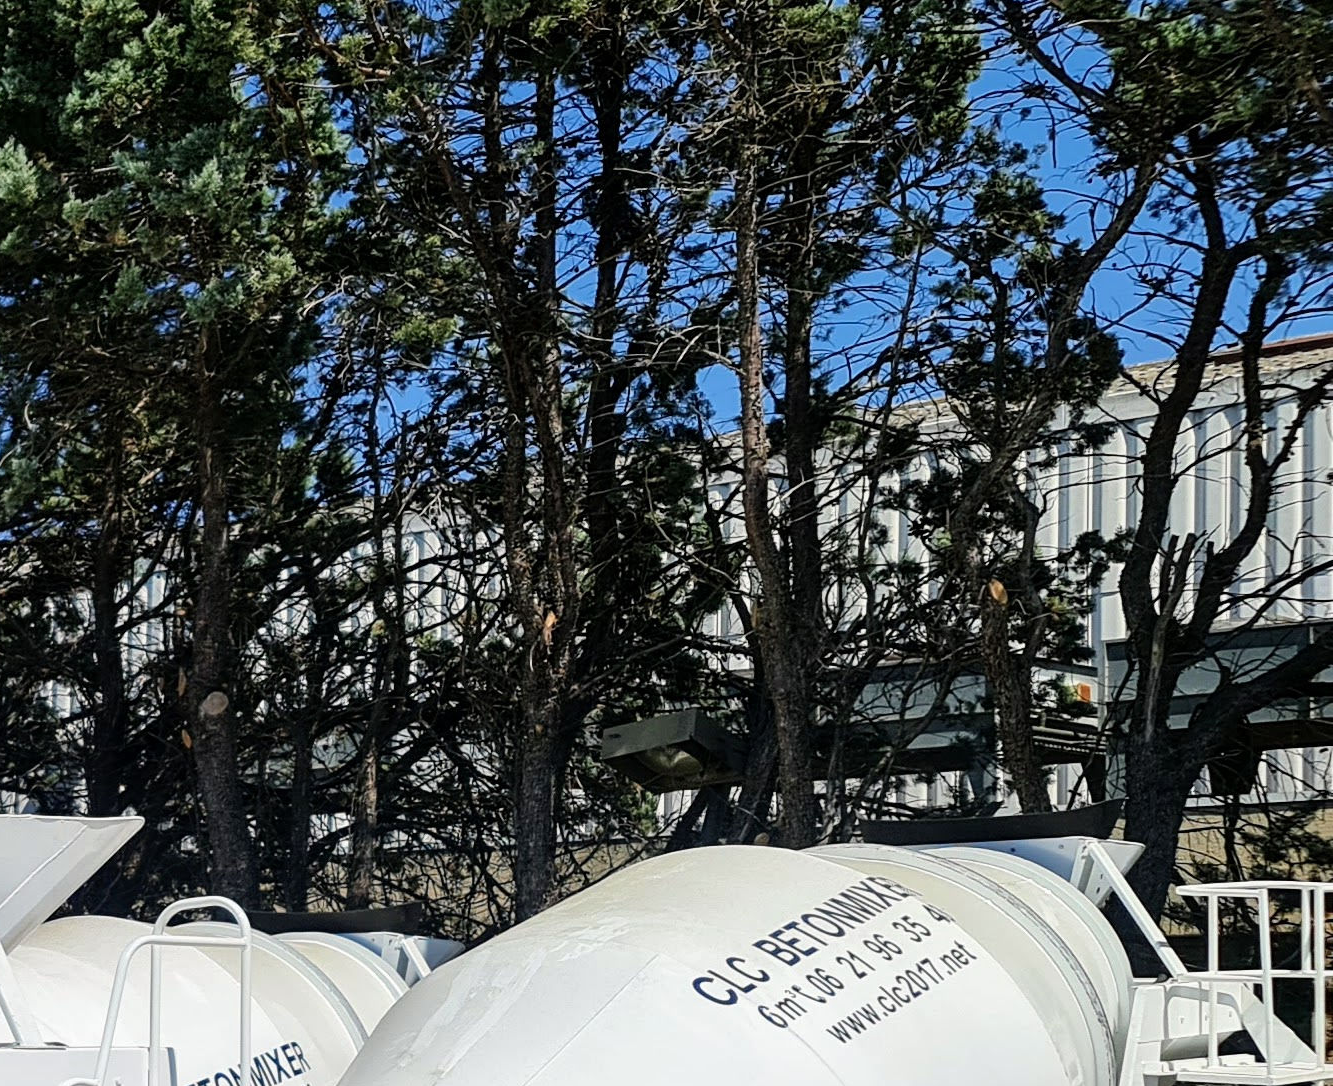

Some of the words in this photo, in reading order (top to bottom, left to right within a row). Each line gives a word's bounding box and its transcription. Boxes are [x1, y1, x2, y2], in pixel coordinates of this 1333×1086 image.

[692, 956, 770, 1005] CLC
[806, 968, 844, 996] 06
[836, 950, 876, 979] 21
[863, 934, 903, 961] 96
[891, 915, 931, 942] 35
[826, 940, 977, 1044] www.clc2017.net
